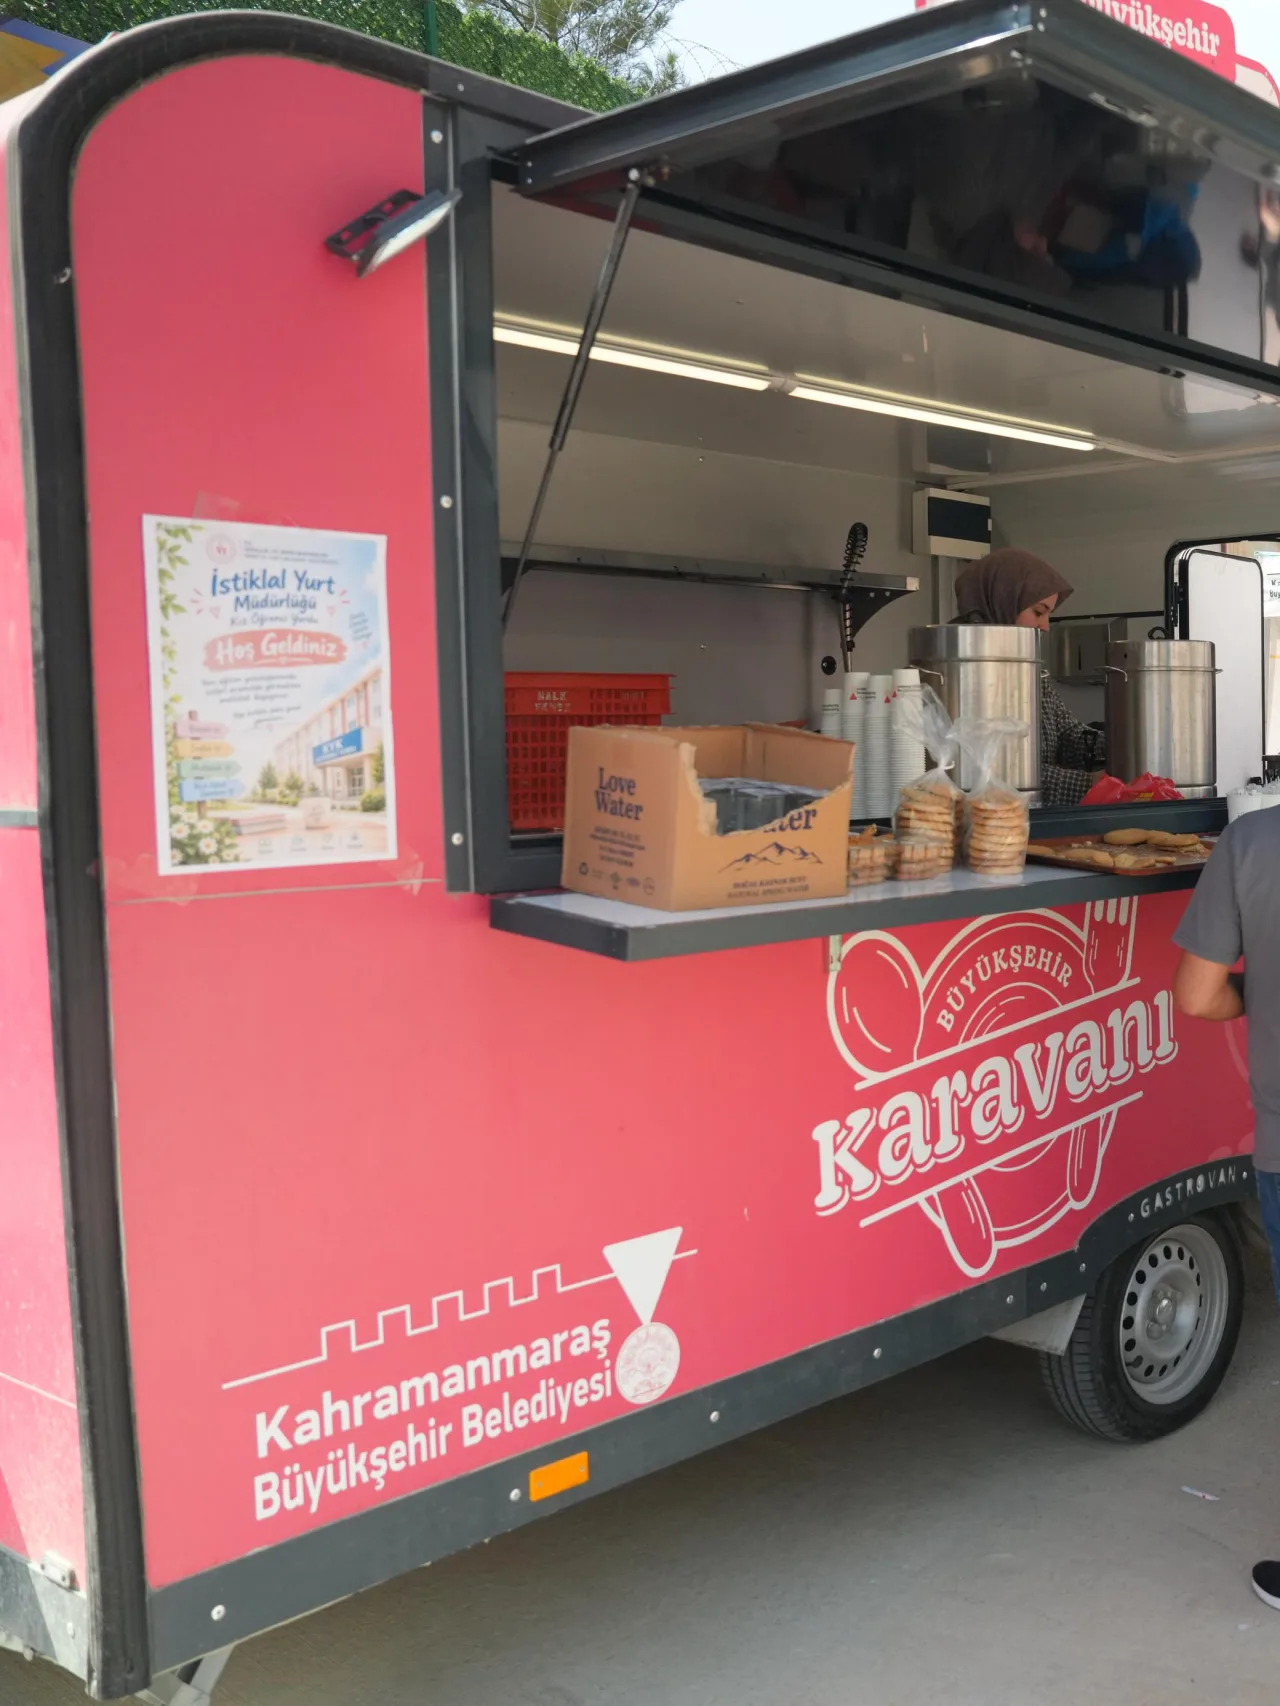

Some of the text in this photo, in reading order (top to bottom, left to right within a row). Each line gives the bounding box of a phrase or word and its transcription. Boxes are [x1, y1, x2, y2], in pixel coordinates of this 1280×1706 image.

[1084, 0, 1220, 57] yükşehir
[211, 568, 336, 597] İstiklal Yurt
[234, 594, 317, 614] Müdürlüğü
[216, 632, 338, 665] Hoş Geldiniz
[598, 766, 636, 796] Love
[594, 790, 644, 821] Water
[936, 943, 1073, 1034] BÜYÜKŞEHİR
[1140, 1164, 1236, 1218] GASTROVAN
[255, 1317, 611, 1459] Kahramanmaraş
[253, 1359, 612, 1521] Büyükşehir Belediyesi
